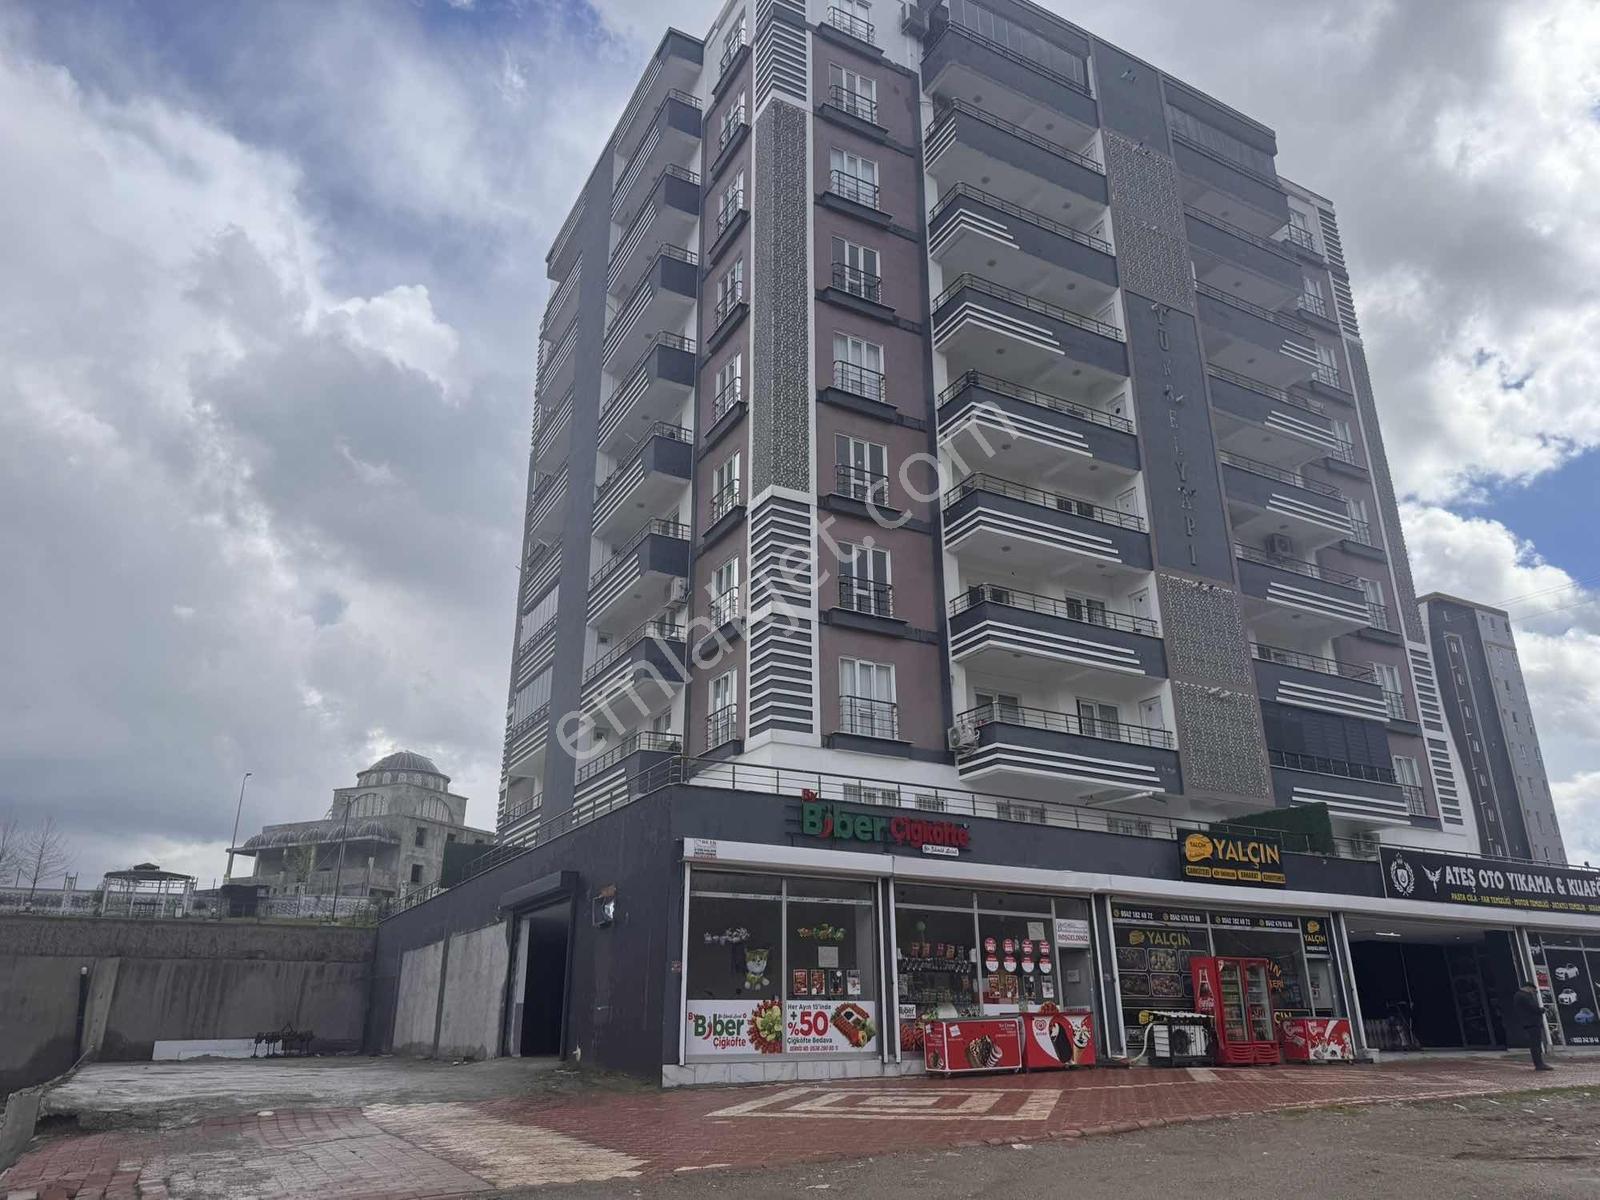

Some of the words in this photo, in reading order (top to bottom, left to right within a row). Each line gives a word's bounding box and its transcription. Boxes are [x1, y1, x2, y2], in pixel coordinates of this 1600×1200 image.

[802, 802, 885, 841] Biber
[1213, 838, 1280, 869] YALÇIN
[1446, 866, 1476, 893] ATEŞ
[1479, 870, 1505, 890] OTO
[1506, 872, 1554, 895] YIKAMA
[1556, 877, 1567, 895] &
[1146, 930, 1191, 948] YALÇIN
[1304, 934, 1326, 945] YALÇIN
[694, 1014, 745, 1040] Biber
[713, 1037, 746, 1049] Çiğköfte
